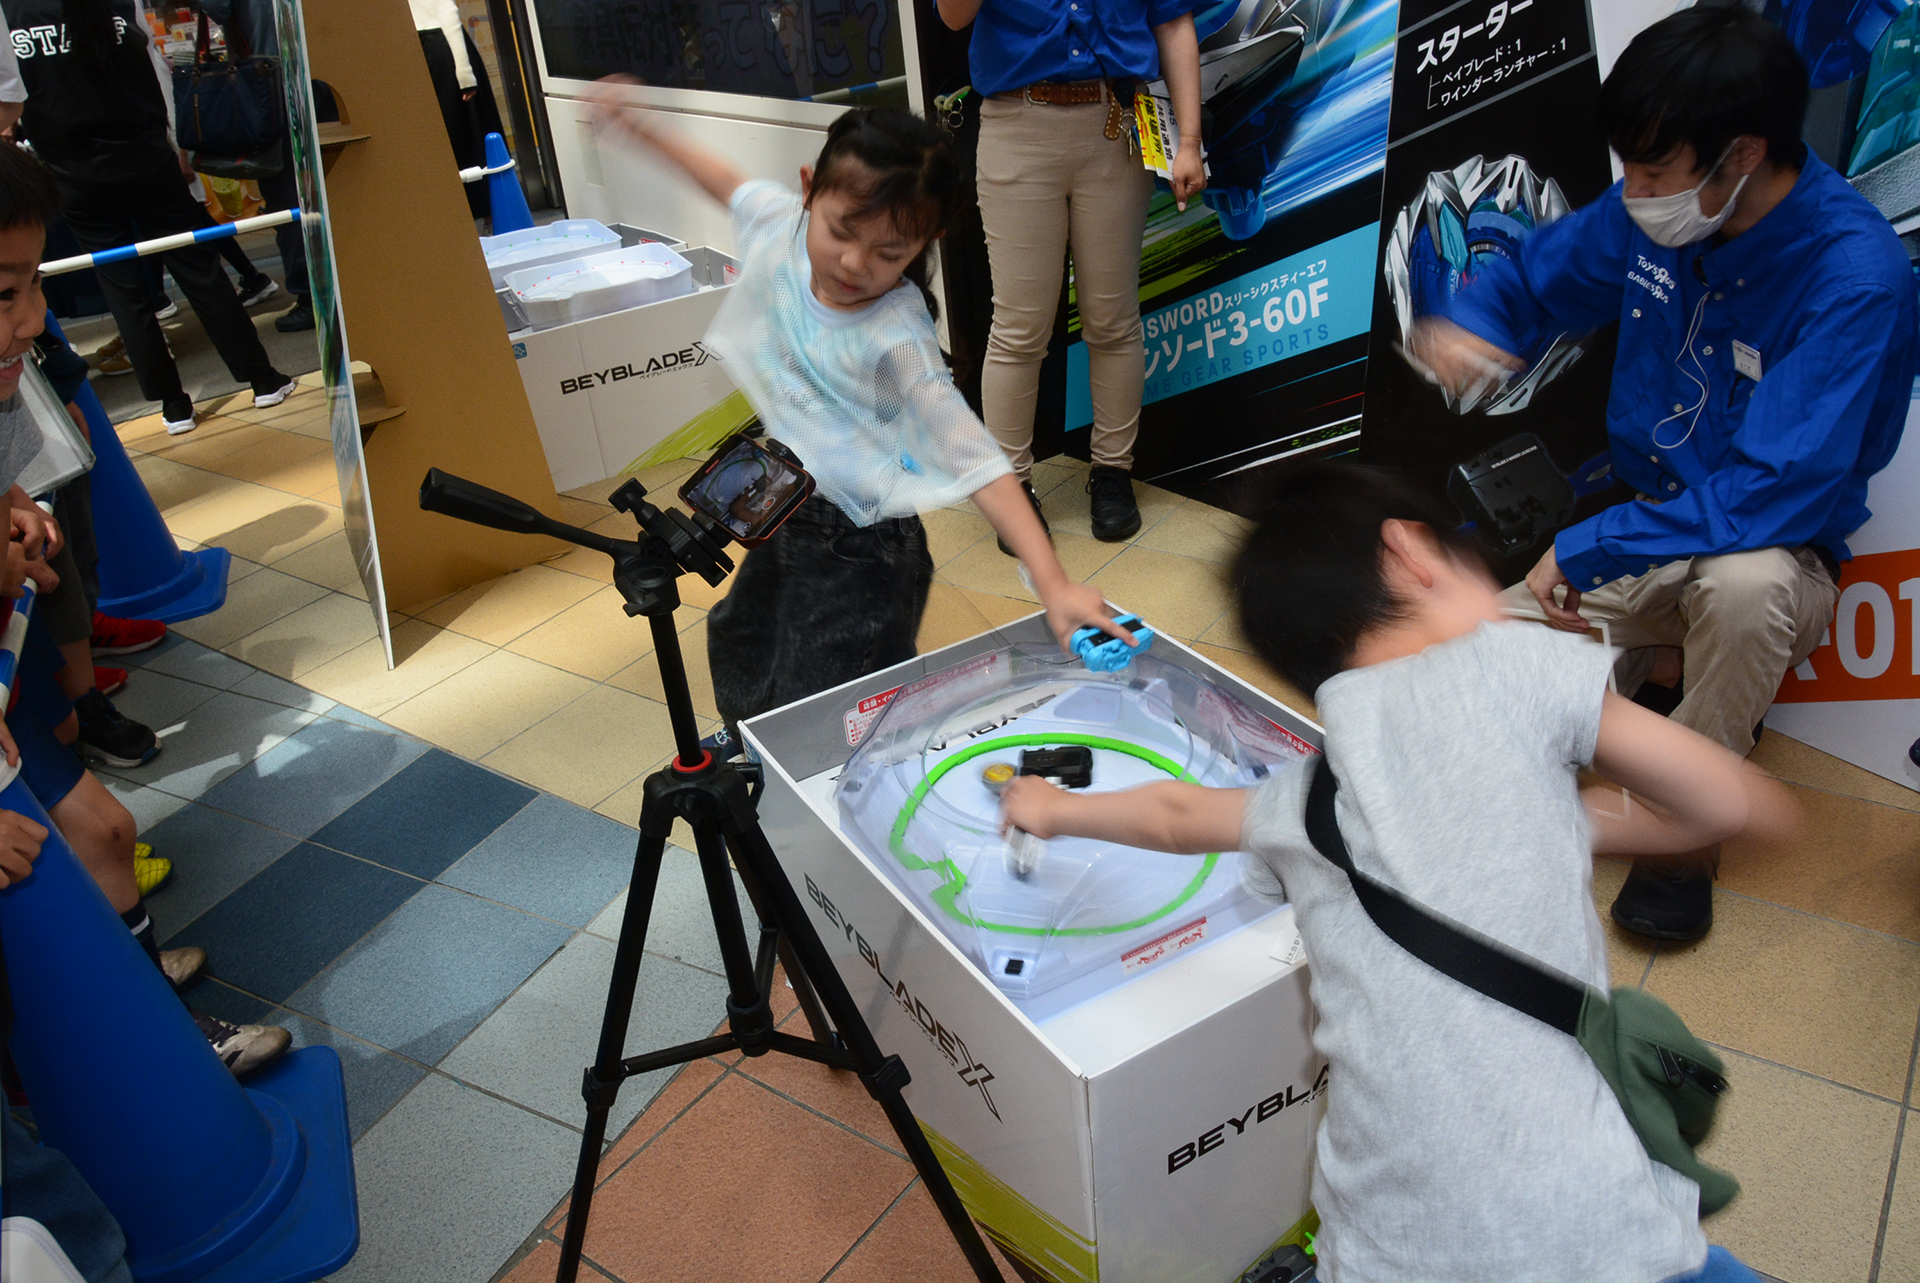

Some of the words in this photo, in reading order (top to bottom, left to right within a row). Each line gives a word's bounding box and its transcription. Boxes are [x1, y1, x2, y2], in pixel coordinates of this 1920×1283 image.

[1416, 0, 1533, 75] スターター
[1181, 356, 1232, 387] GEAR
[1243, 323, 1330, 367] SPORTS
